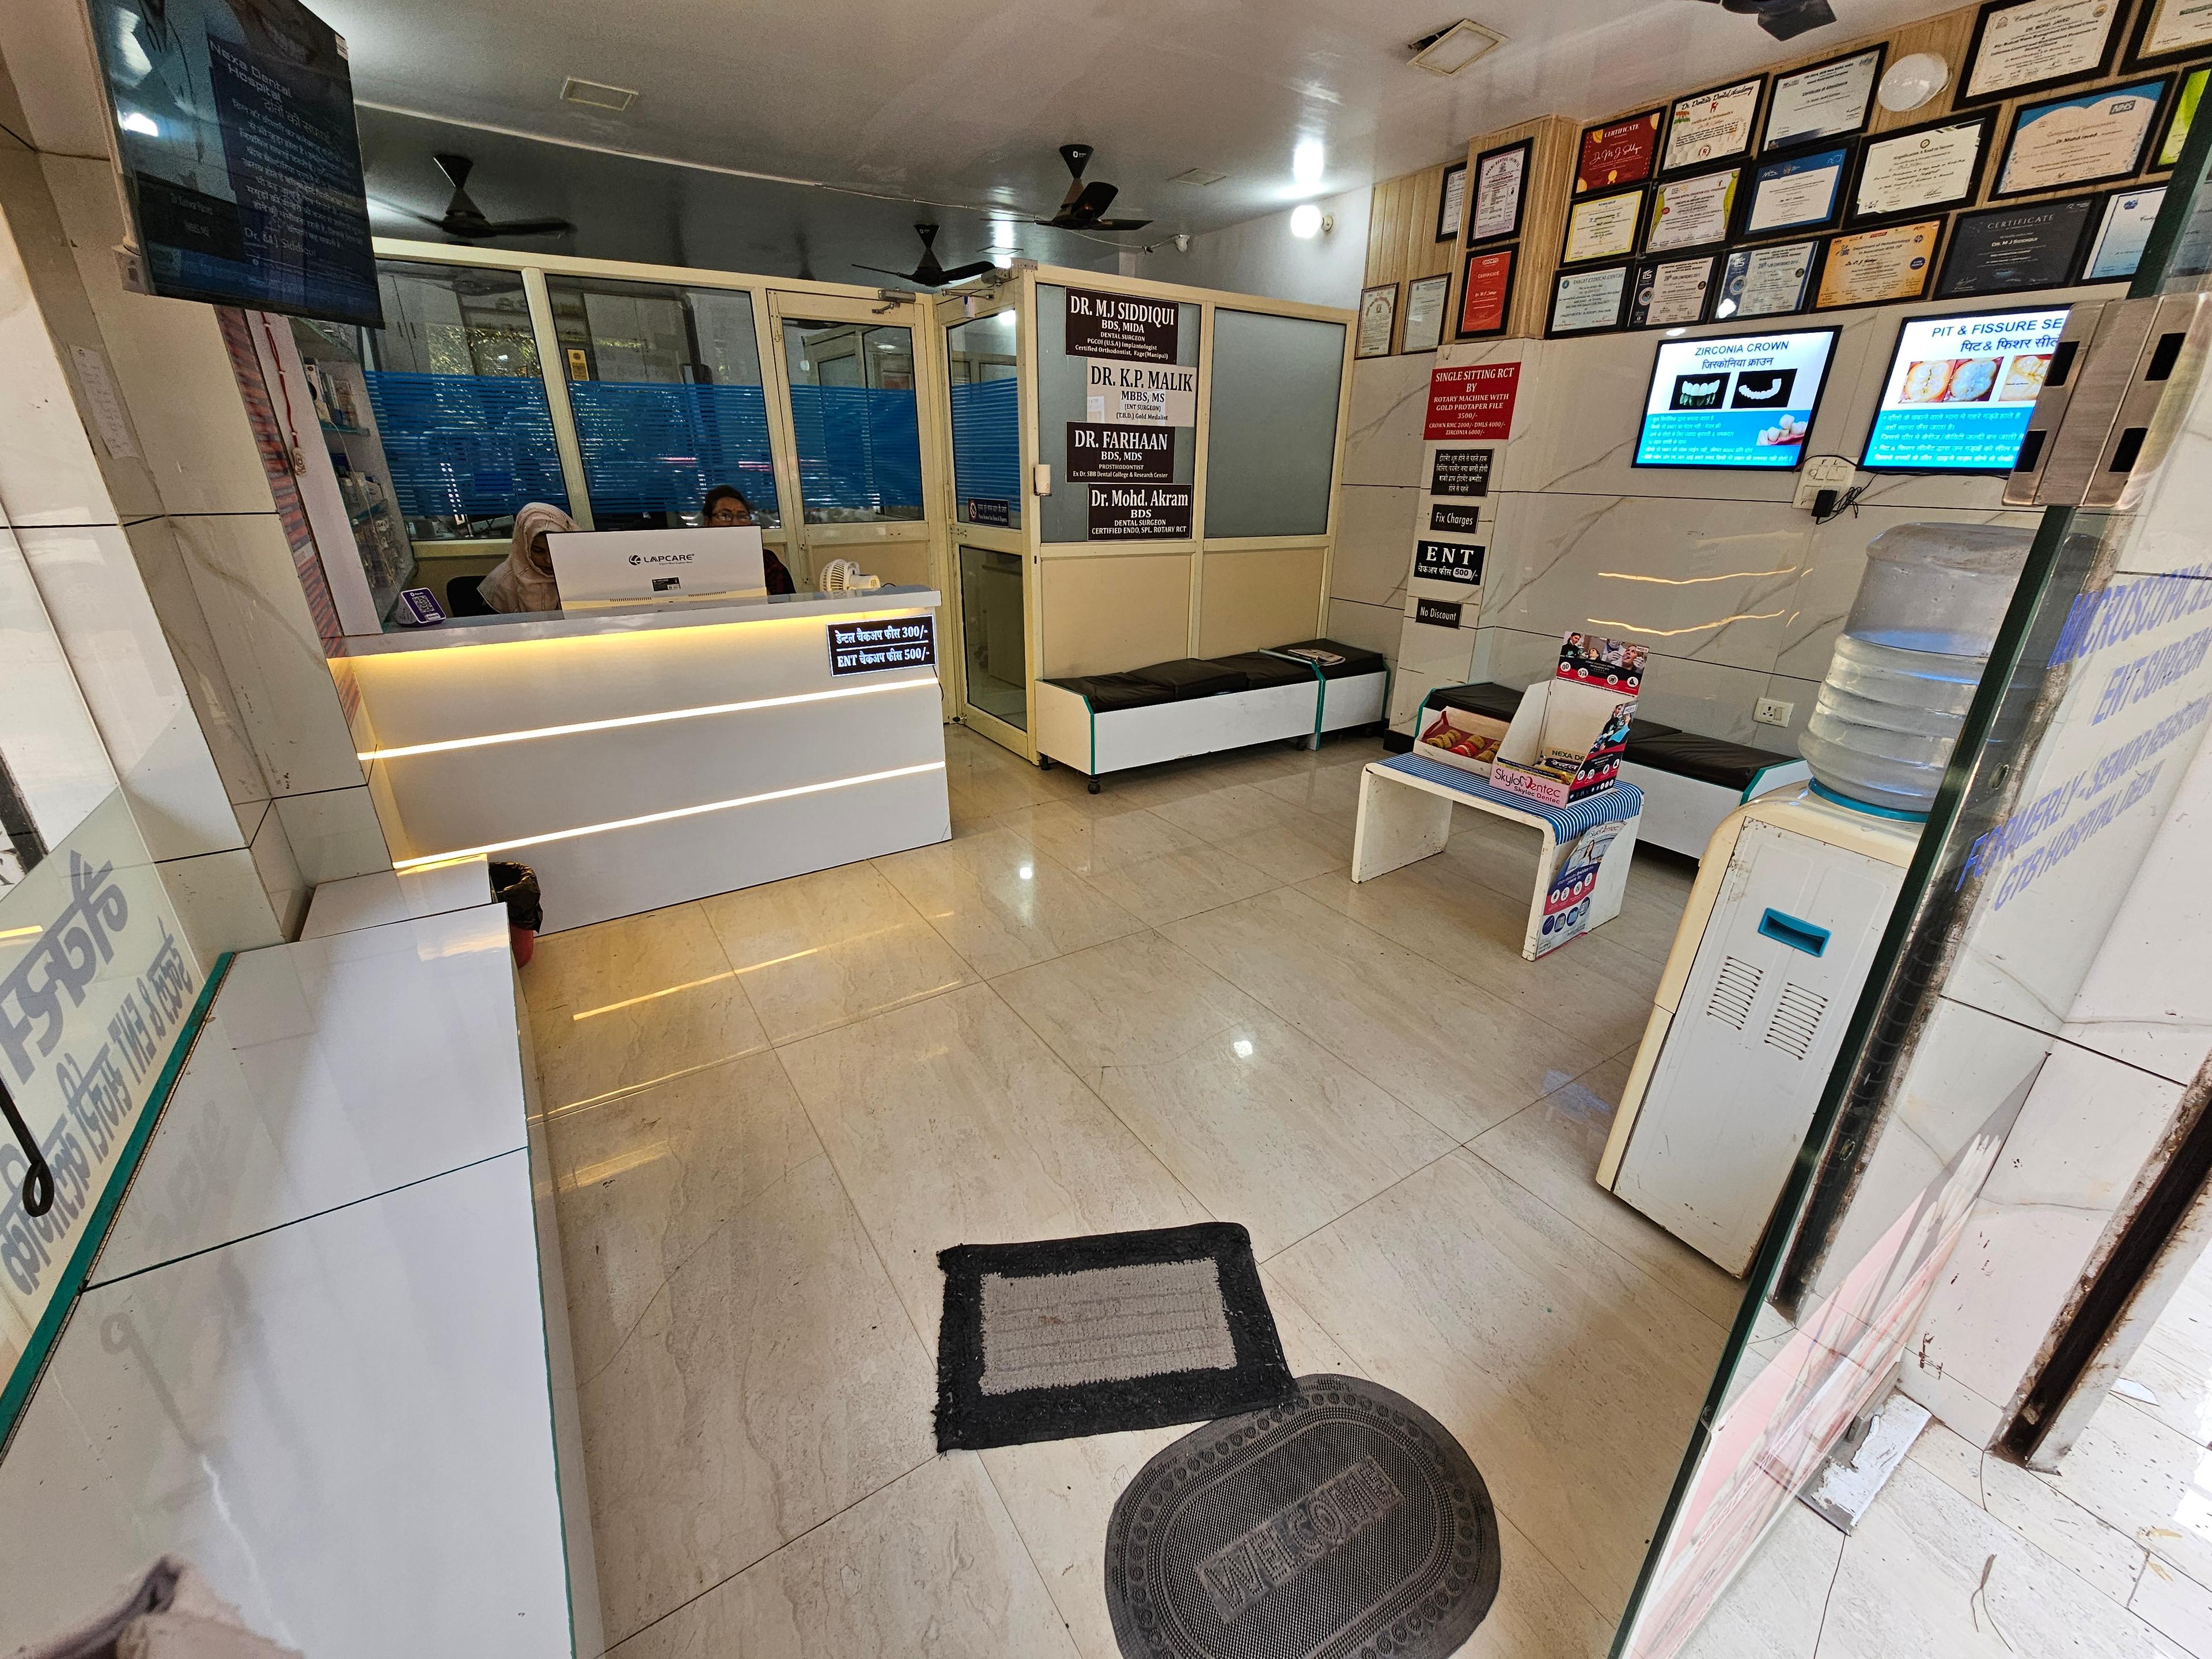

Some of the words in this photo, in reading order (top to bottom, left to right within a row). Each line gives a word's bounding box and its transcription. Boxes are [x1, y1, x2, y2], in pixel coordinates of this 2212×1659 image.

[1604, 123, 1640, 138] CERTIFICATE
[1987, 214, 2055, 229] CERTIFICATE
[1070, 295, 1093, 316] DR.
[1118, 302, 1175, 328] SIDDIQUI
[1101, 319, 1121, 332] BDS,
[1122, 322, 1145, 334] MIDA
[1931, 327, 1954, 338] PIT
[1957, 325, 1967, 335] &
[1971, 320, 2037, 335] FISSURE
[1100, 331, 1121, 340] DENTAL
[1075, 344, 1097, 353] Certified
[1099, 346, 1132, 356] Orthodontist,
[1122, 342, 1157, 351] Implantologist
[1695, 345, 1744, 356] ZIRCONIA
[1747, 341, 1789, 351] CROWN
[1960, 340, 1982, 353] पिट
[1983, 342, 1992, 351] &
[1996, 337, 2032, 350] फिशर
[1702, 357, 1747, 370] जिरकोनिया
[1747, 357, 1775, 367] क्राउन
[1090, 365, 1116, 386] DR.
[1120, 368, 1144, 389] K.P.
[1148, 370, 1193, 392] MALIK
[1435, 372, 1463, 382] SINGLE
[1464, 369, 1496, 381] SITTING
[1497, 367, 1514, 378] RCT
[1466, 382, 1478, 393] BY
[1121, 390, 1150, 403] MBBS,
[1152, 392, 1165, 403] MS
[1434, 395, 1457, 403] ROTARY
[1074, 430, 1099, 448] DR.
[1103, 431, 1168, 450] FARHAAN
[1101, 451, 1122, 461] BDS,
[1123, 452, 1143, 461] MDS
[1091, 490, 1108, 507] Dr.
[1111, 490, 1148, 507] Mohd.
[1150, 489, 1188, 506] Akram
[1130, 509, 1152, 518] BDS
[1435, 512, 1445, 523] Fix
[1446, 513, 1474, 527] Charges
[643, 554, 692, 563] LAPCARE
[1425, 546, 1474, 565] ENT
[1438, 566, 1452, 576] फीस
[1453, 567, 1478, 581] 500/-
[1420, 607, 1429, 617] No
[1430, 607, 1457, 622] Discount
[2046, 563, 2203, 669] MICROSCOPIC
[856, 627, 883, 642] चैकअप
[883, 625, 901, 640] फीस
[902, 624, 928, 639] 300/-
[837, 654, 858, 668] ENT
[858, 650, 885, 665] चैकअप
[886, 647, 903, 662] फीस
[904, 646, 930, 661] 500/-
[2090, 655, 2149, 727] ENT
[1552, 750, 1573, 760] NEXA
[1536, 793, 1560, 804] Dentec
[1954, 769, 2088, 893] FORMERLY
[2085, 729, 2153, 801] SENIOR
[1994, 846, 2046, 911] GTB
[2036, 789, 2123, 878] HOSPITAL
[2115, 758, 2166, 818] DELHI
[1203, 1461, 1400, 1611] WELCOME
